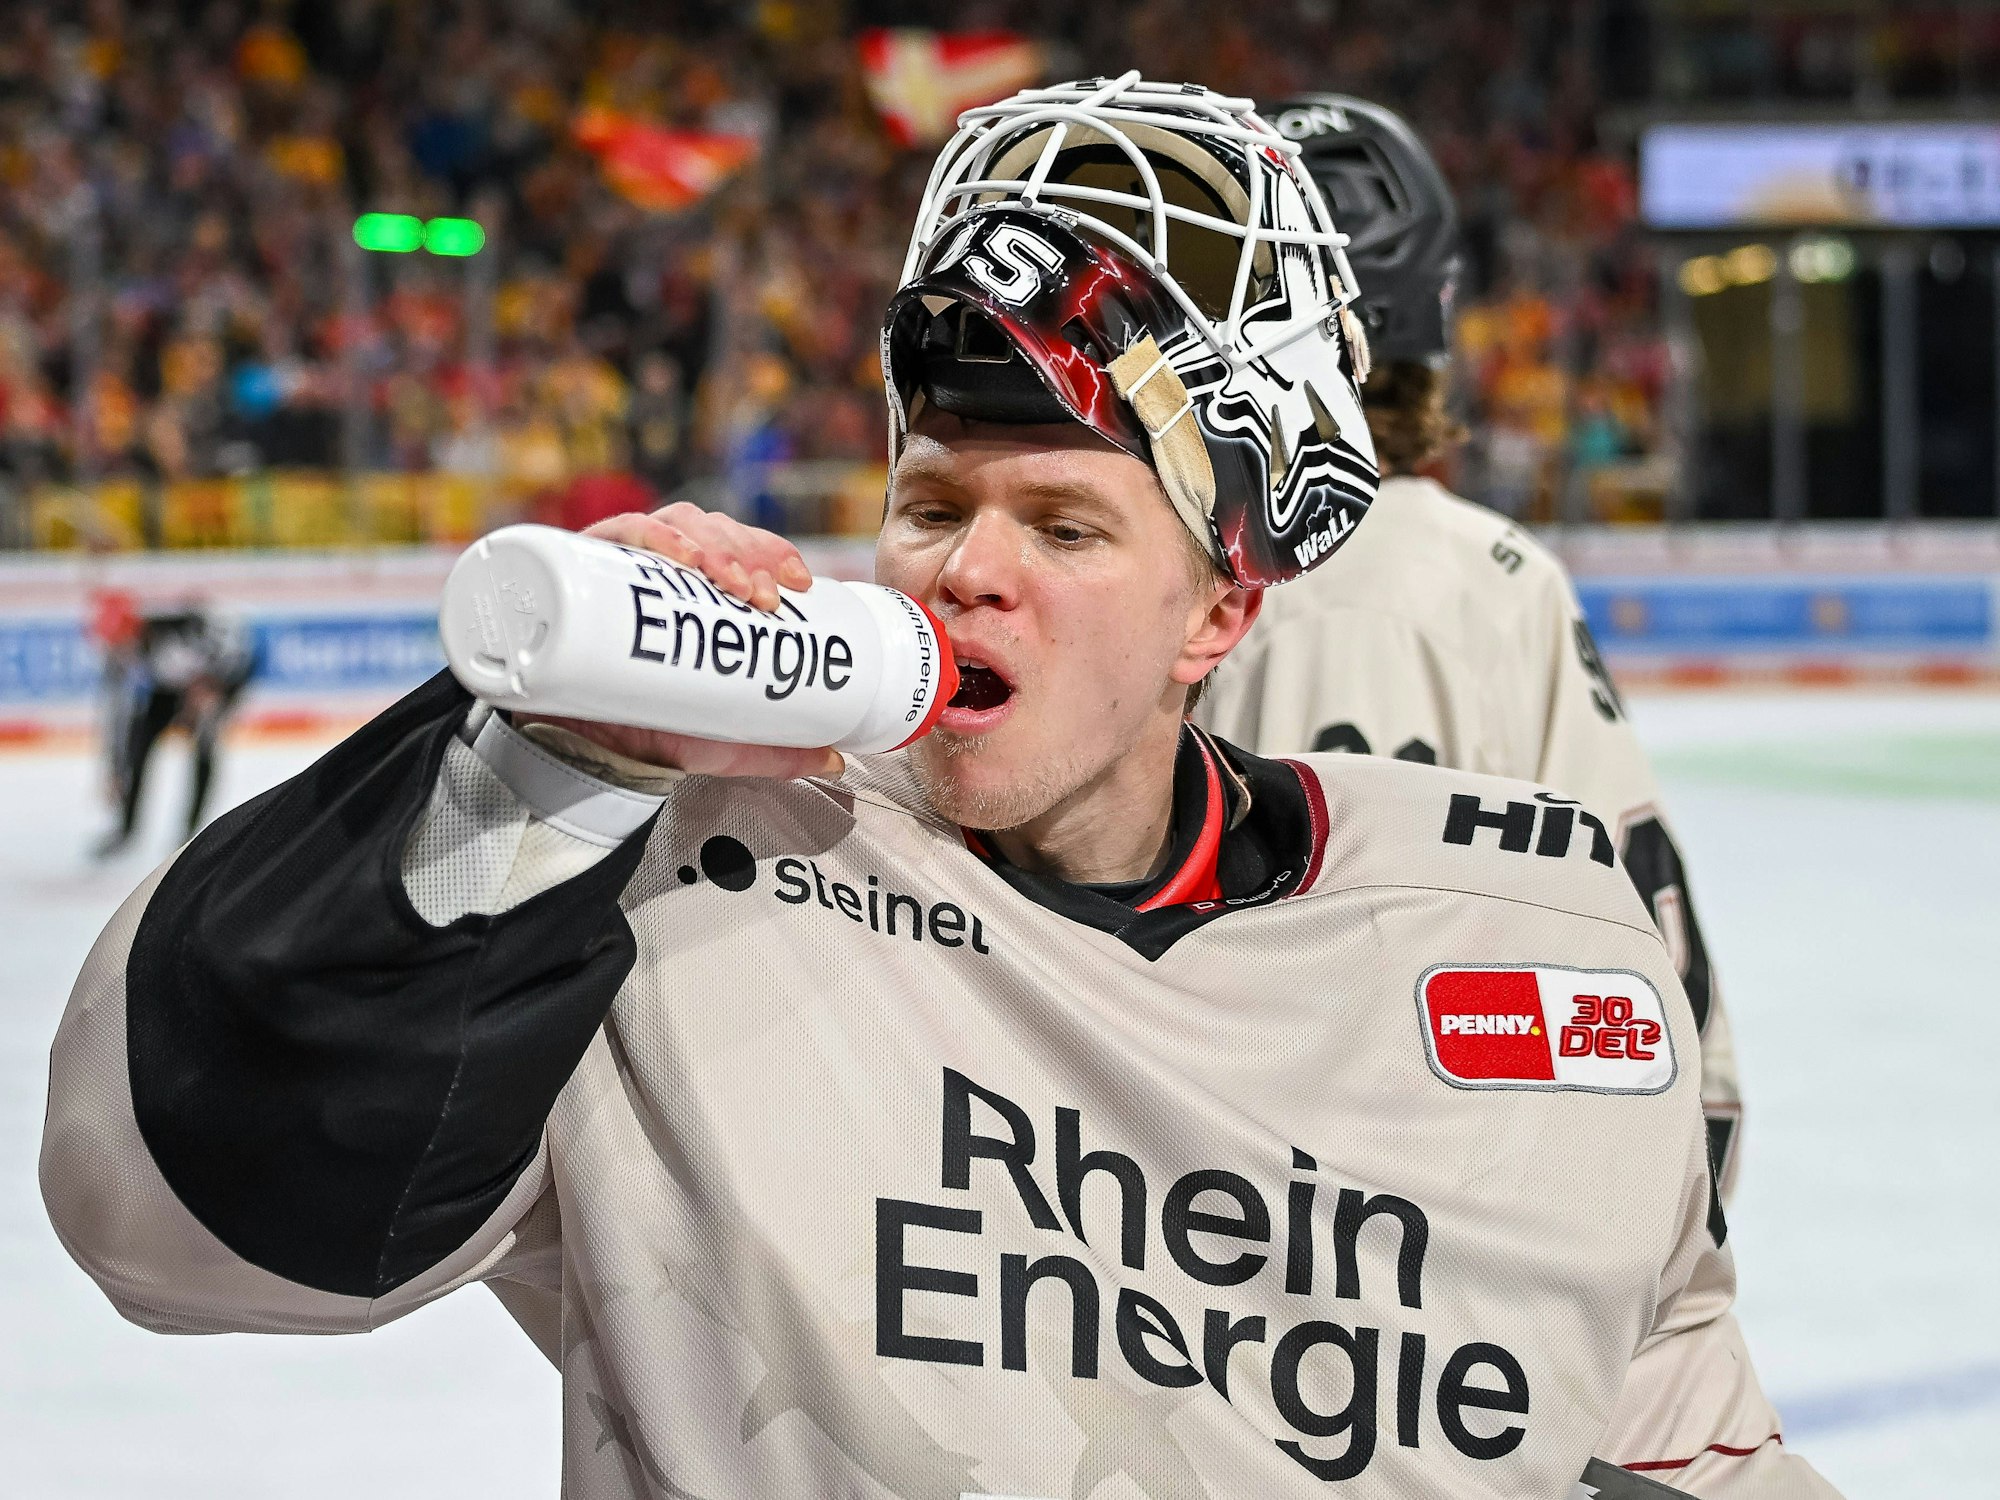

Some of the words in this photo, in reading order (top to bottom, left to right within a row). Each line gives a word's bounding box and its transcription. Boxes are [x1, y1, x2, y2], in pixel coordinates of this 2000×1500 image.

[630, 584, 853, 702] Energie
[884, 587, 932, 723] heinEnergie
[774, 858, 990, 955] Steinel
[1571, 994, 1633, 1027] 30
[940, 1065, 1430, 1311] Rhein
[875, 1196, 1531, 1483] Energie
